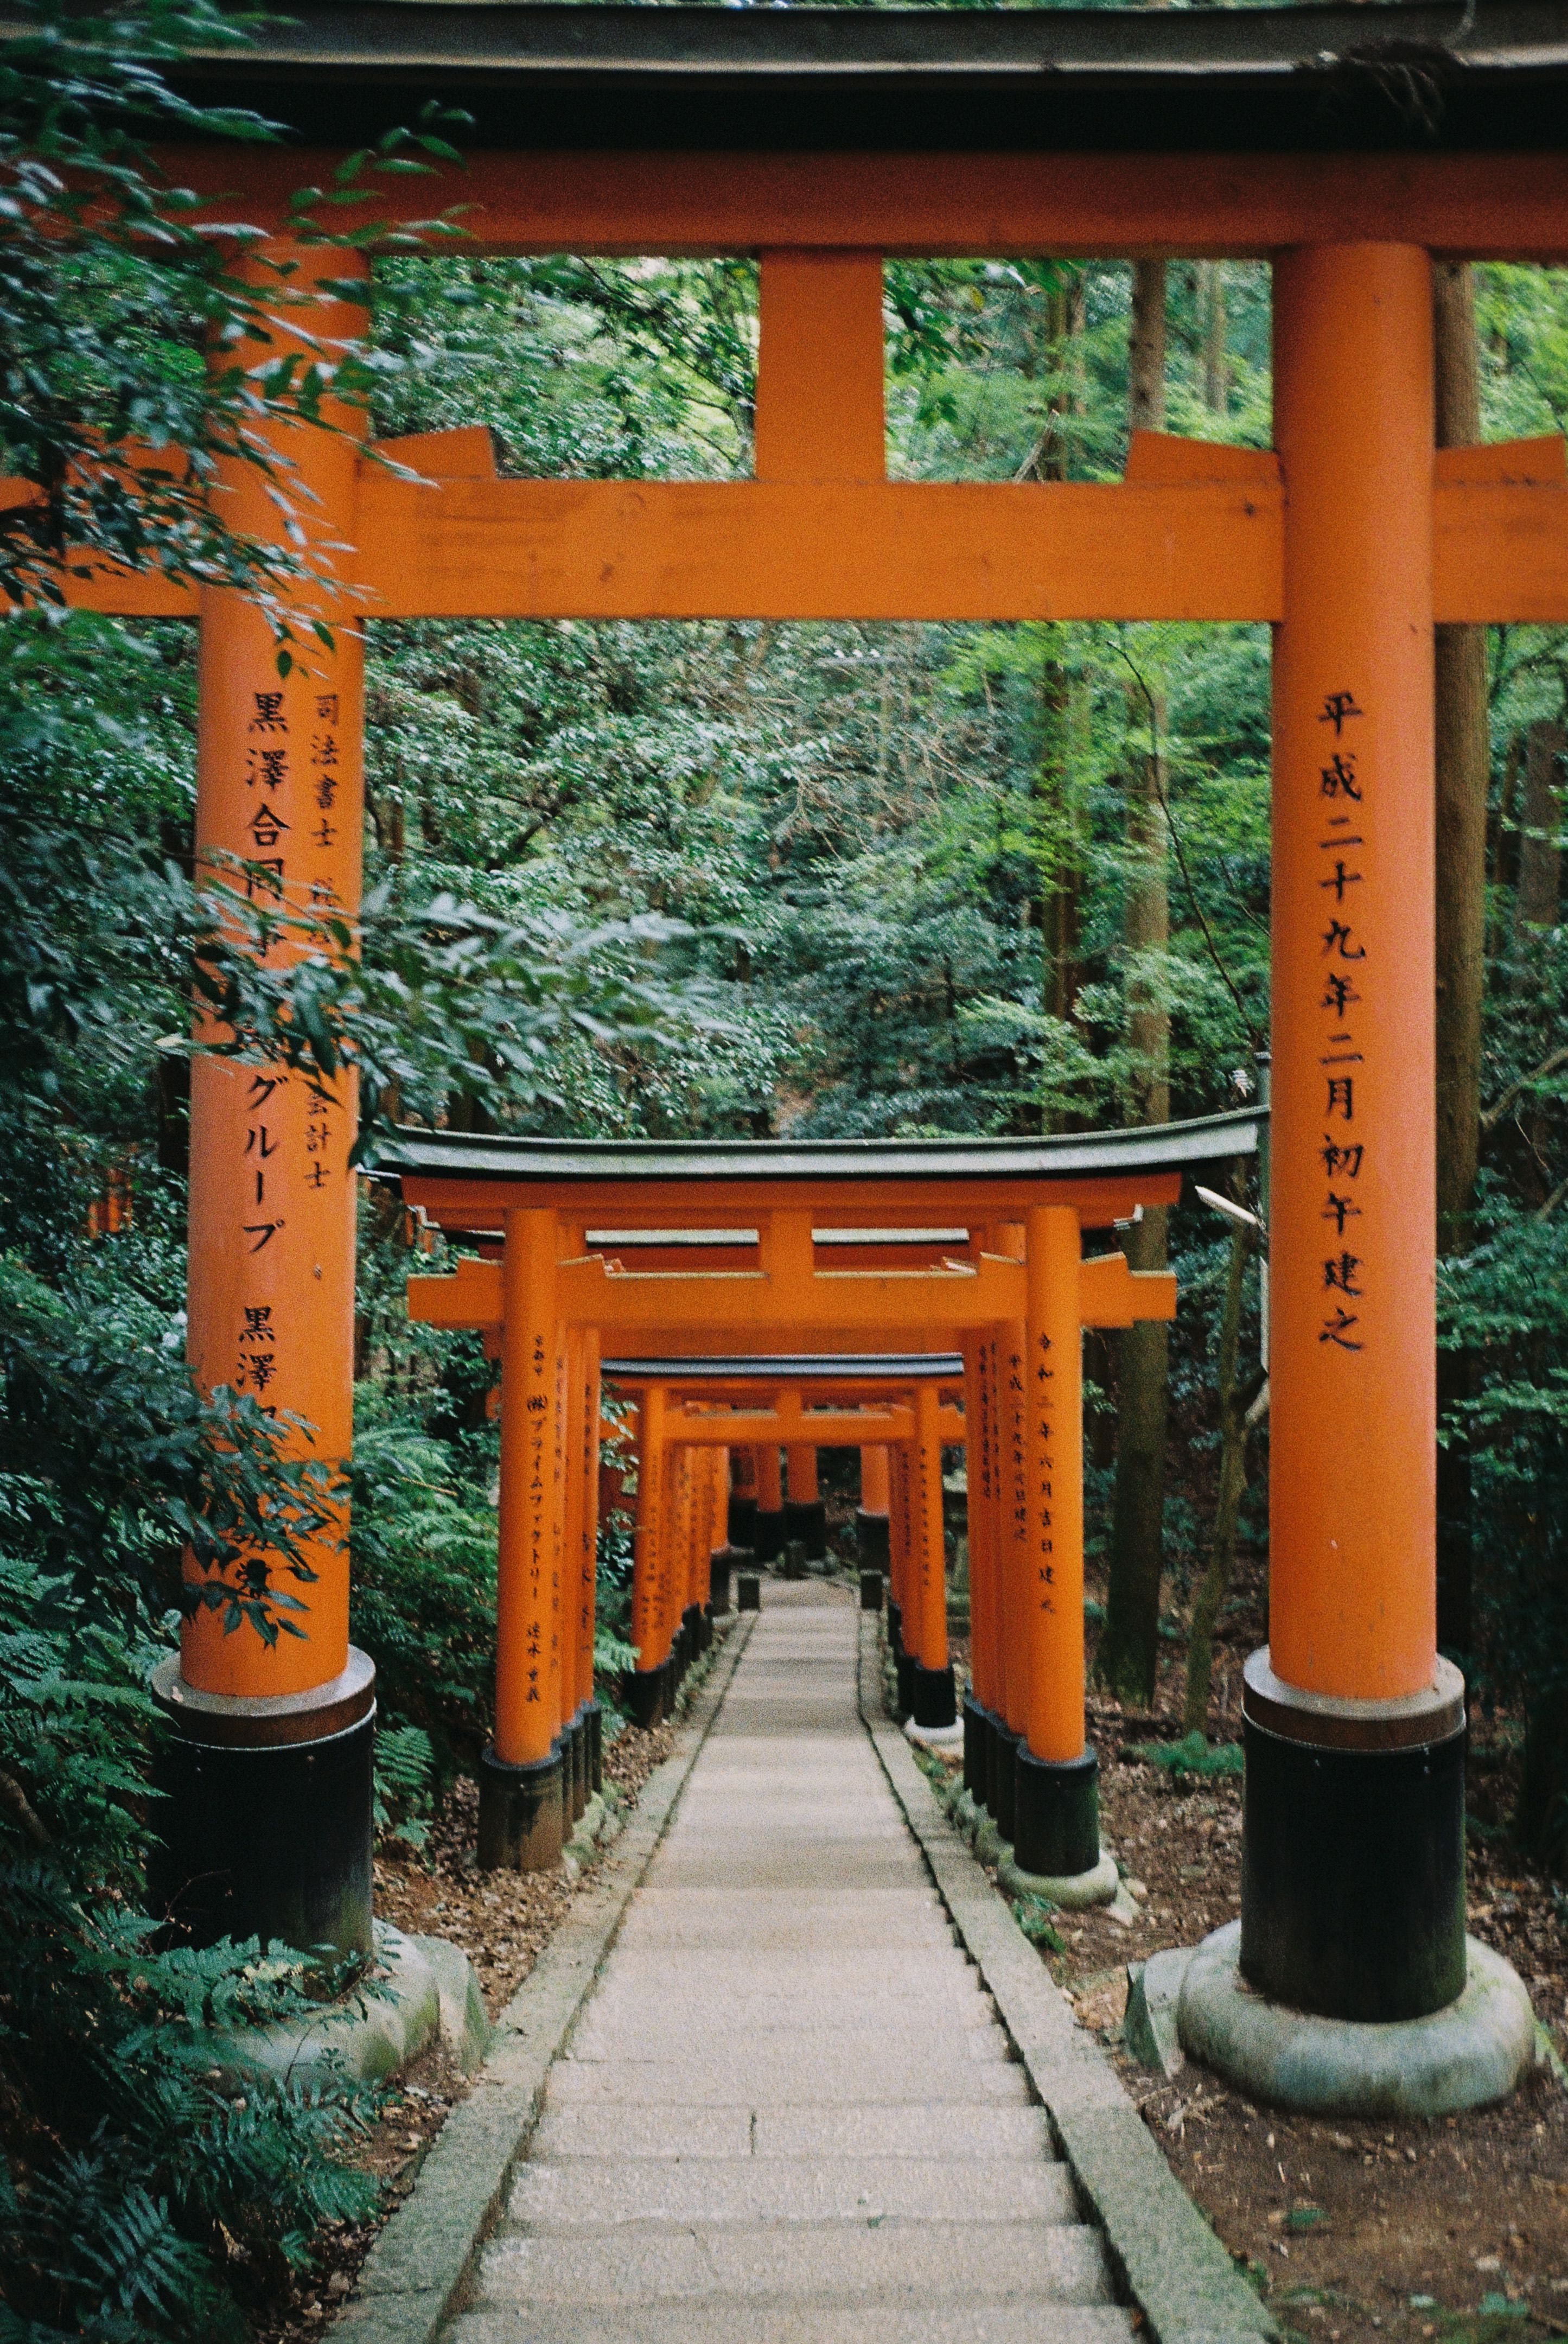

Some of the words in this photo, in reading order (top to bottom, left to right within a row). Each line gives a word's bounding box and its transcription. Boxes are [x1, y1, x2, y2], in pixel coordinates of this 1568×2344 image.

[310, 693, 339, 847] 司法書士
[1317, 691, 1366, 1352] 平成二十九年二月初午建之
